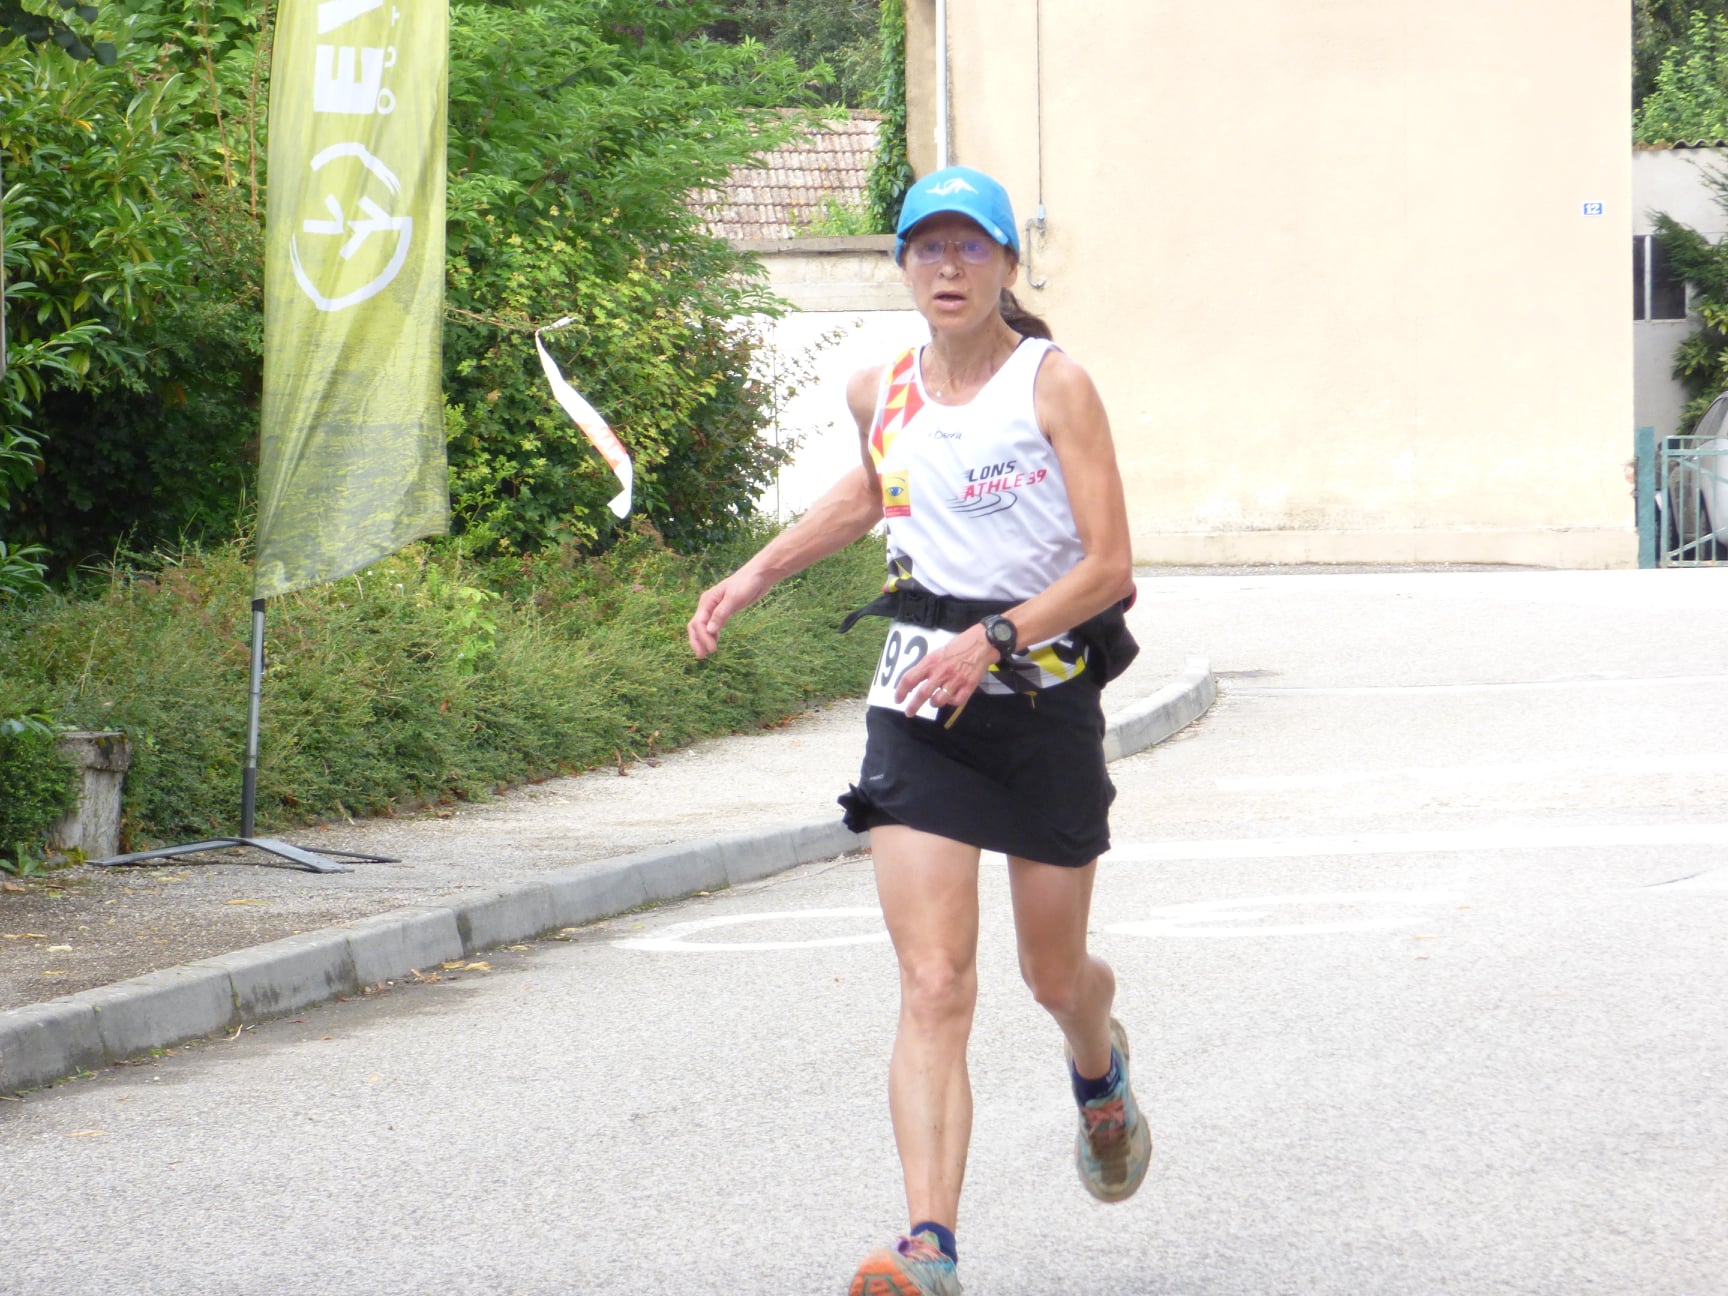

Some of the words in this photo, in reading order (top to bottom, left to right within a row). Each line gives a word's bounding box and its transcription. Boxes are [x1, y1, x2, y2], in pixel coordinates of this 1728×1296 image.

[1586, 203, 1600, 214] 12
[967, 459, 1017, 482] LONS
[964, 473, 1025, 500] ATHLE
[1026, 468, 1048, 486] 39
